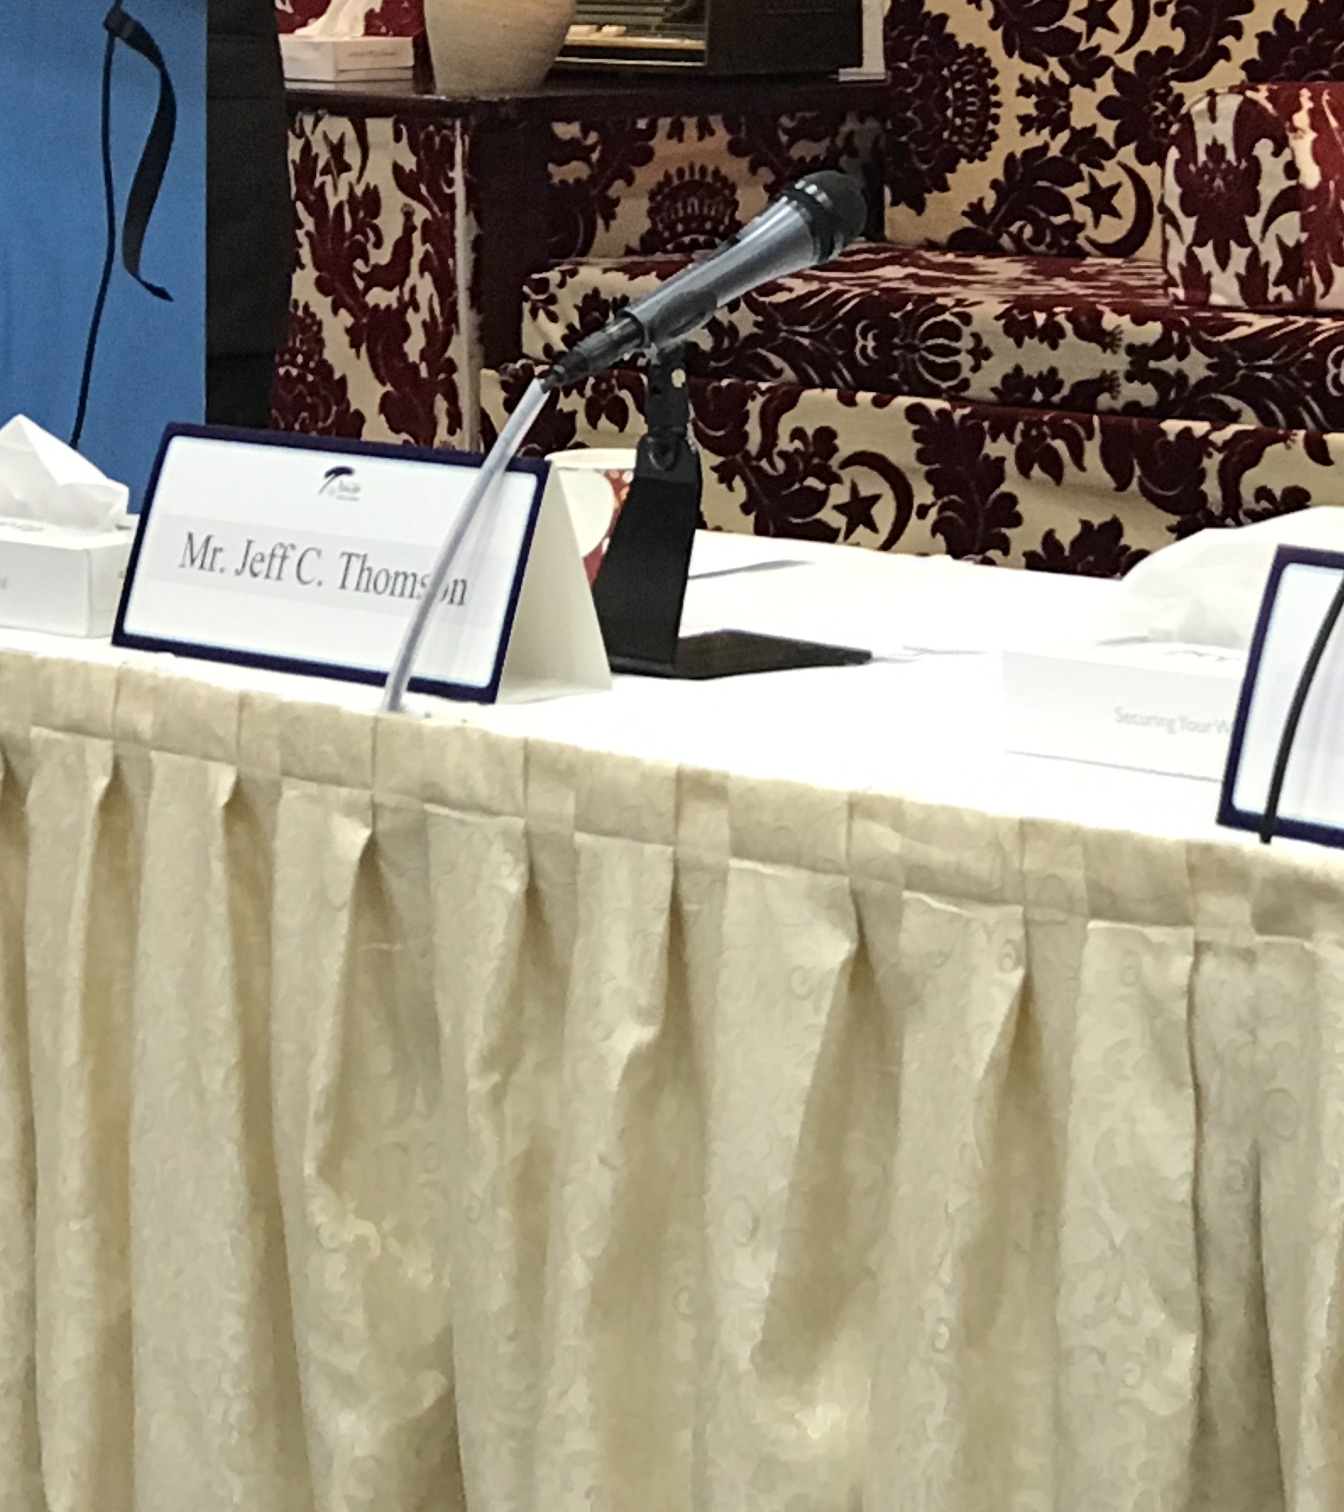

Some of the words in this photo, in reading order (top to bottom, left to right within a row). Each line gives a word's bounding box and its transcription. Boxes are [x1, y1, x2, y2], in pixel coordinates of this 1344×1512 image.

[179, 531, 226, 574] Mr.
[234, 538, 298, 582] Jeff
[296, 546, 323, 587] C.
[338, 551, 468, 607] Thomsn
